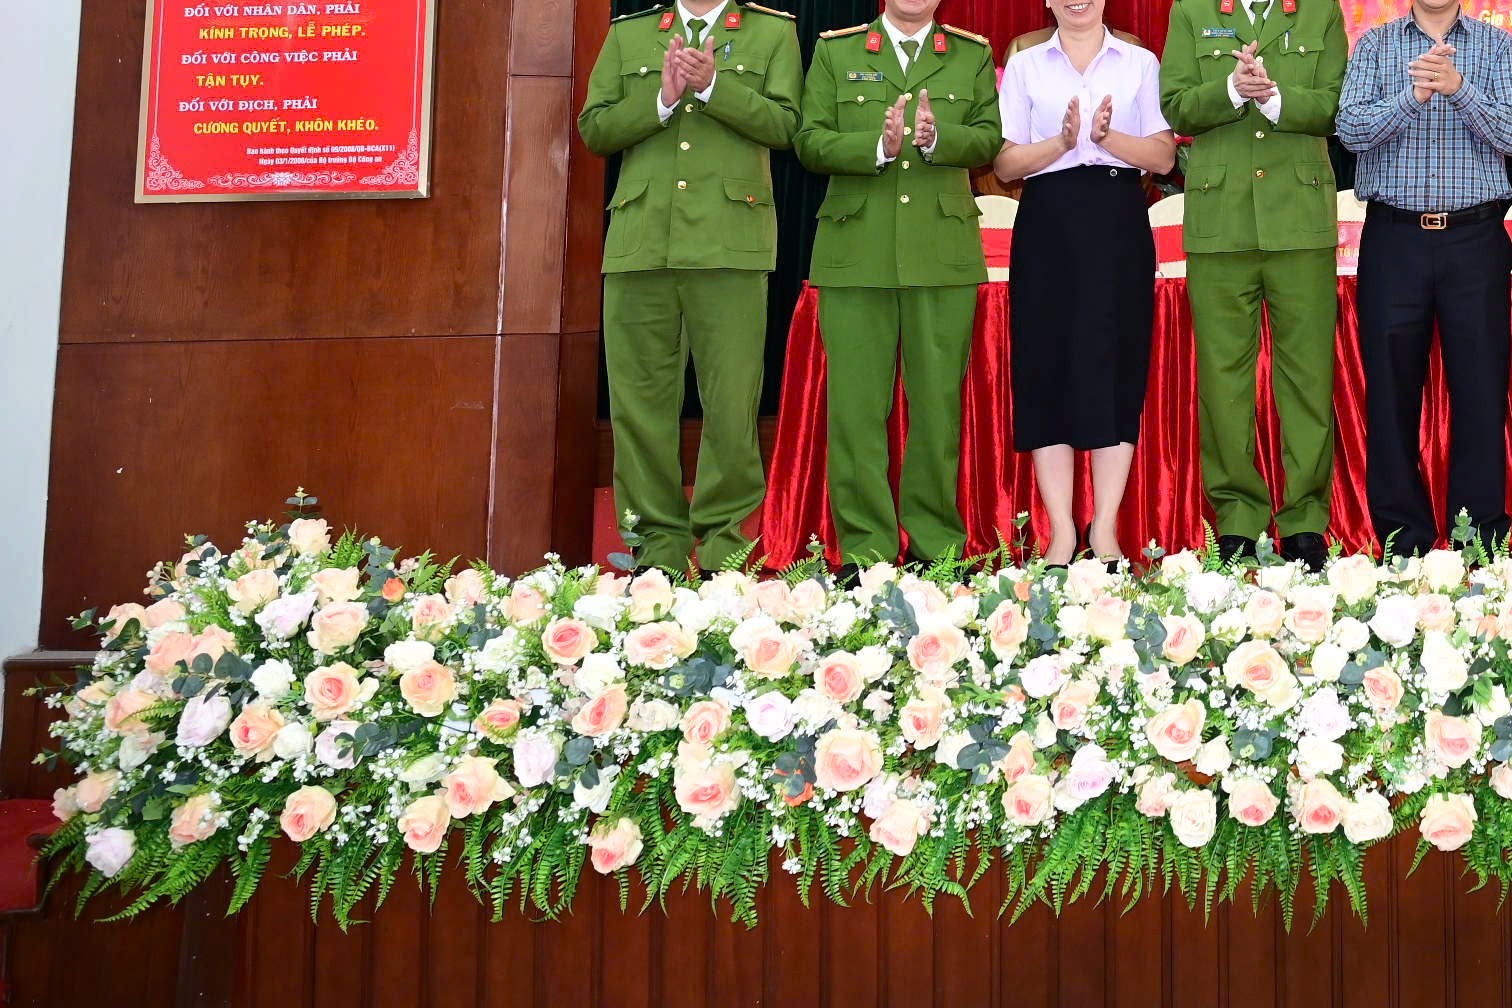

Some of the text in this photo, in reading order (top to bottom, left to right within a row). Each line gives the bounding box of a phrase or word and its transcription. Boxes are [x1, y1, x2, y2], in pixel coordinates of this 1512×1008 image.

[184, 3, 210, 17] ĐỐI
[214, 4, 238, 16] VỚI
[243, 4, 283, 16] NHÂN
[326, 1, 360, 14] PHẢI
[200, 22, 365, 40] KÍNH TRỌNG, LỄ PHÉP.
[197, 76, 263, 88] TẬN TỤY.
[180, 98, 204, 111] ĐỐI
[210, 99, 233, 110] VỚI
[284, 96, 316, 109] PHẢI
[194, 117, 378, 134] CƯƠNG QUYẾT, KHÔN KHÉO.
